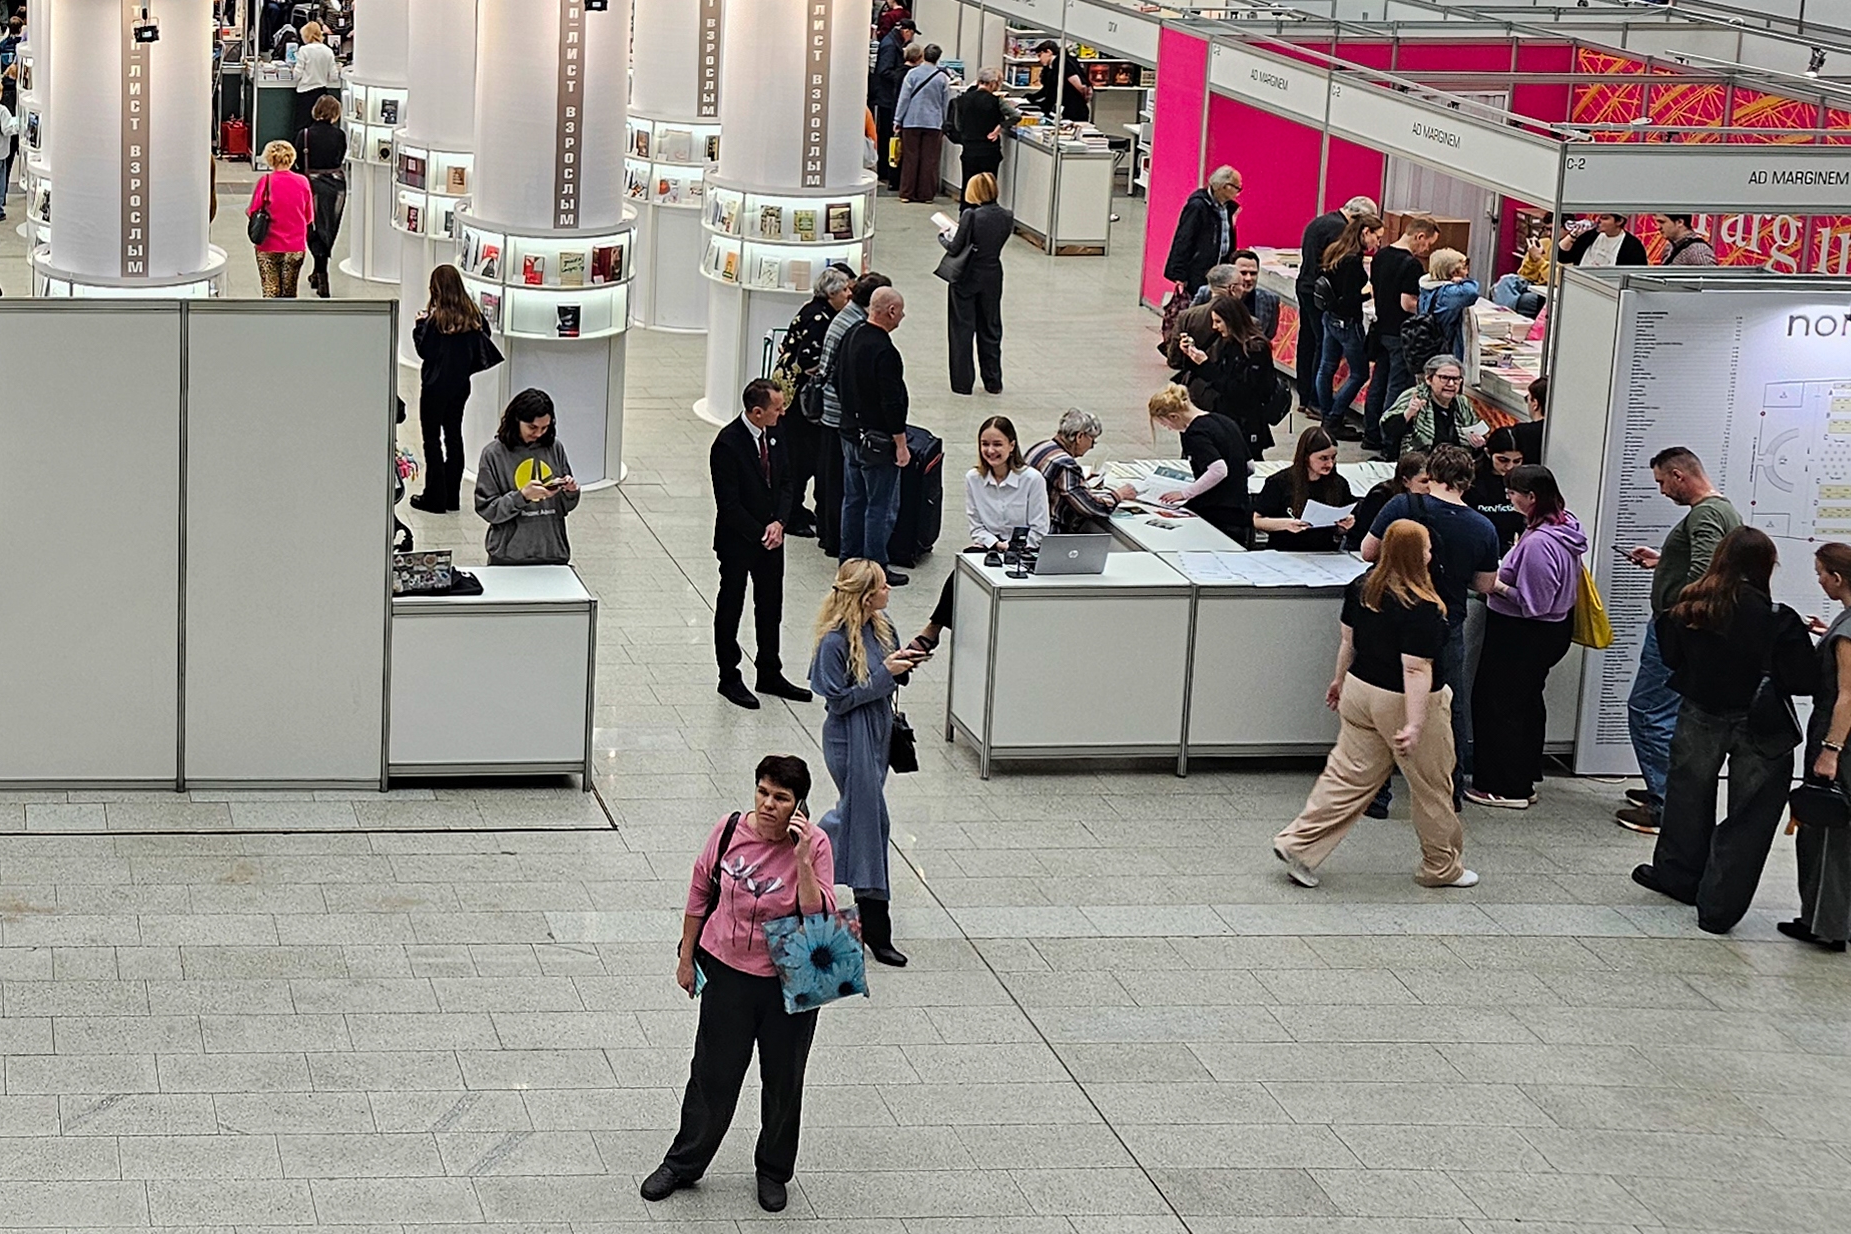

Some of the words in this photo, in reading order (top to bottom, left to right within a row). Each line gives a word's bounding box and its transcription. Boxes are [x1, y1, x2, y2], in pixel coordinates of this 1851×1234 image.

[702, 17, 717, 117] ВЗРОСЛЫМ
[1250, 68, 1261, 82] AD
[1261, 70, 1289, 92] MARGINEM
[805, 74, 824, 187] ВЗРОСЛЫМ
[1411, 122, 1424, 137] AD
[1424, 124, 1462, 150] MARGINEM
[559, 106, 577, 228] ВЗРОСЛЫМ
[1566, 158, 1587, 171] C-2
[1748, 171, 1768, 185] AD
[1771, 171, 1849, 185] MARGINEM
[126, 145, 144, 274] ВЗРОСЛЫМ
